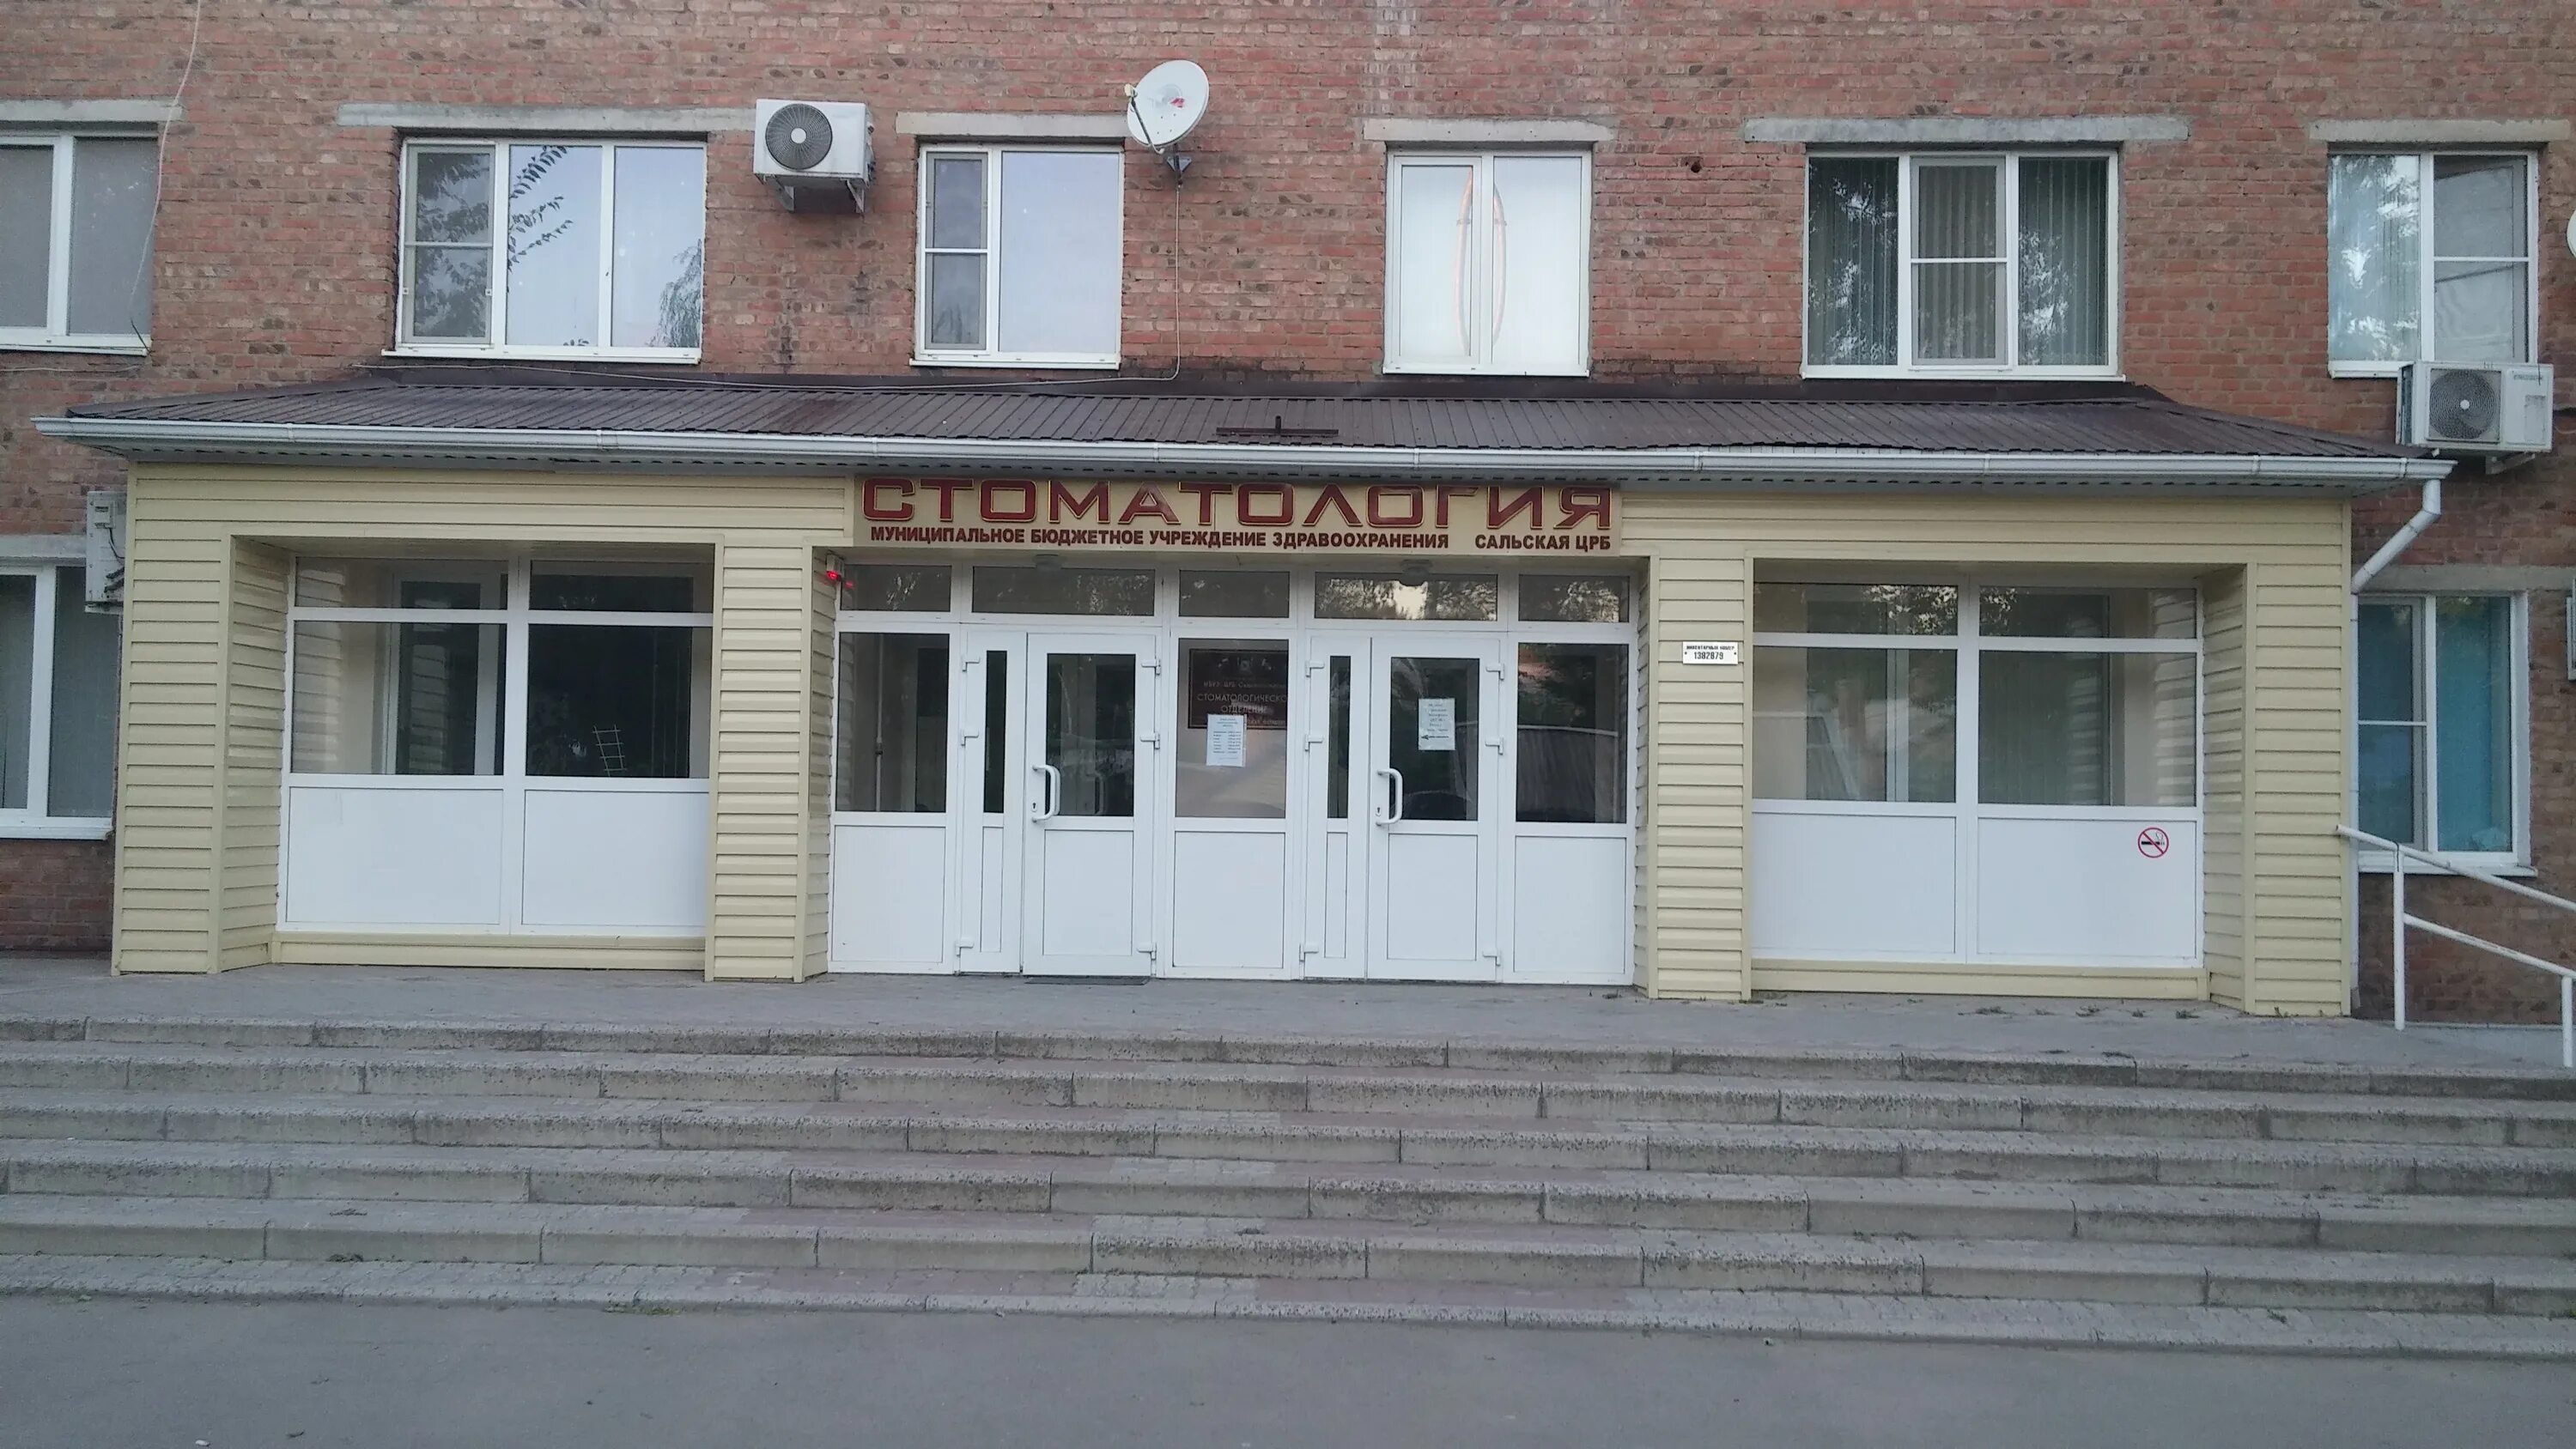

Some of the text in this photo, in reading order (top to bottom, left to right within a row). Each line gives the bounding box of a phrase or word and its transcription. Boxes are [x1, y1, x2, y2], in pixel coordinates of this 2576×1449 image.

[862, 477, 1613, 529] СТОМАТОЛОГИЯ
[871, 526, 1611, 552] МУНИЦИПАЛЬНОЕ БЮДЖЕТНОЕ УЧРЕЖДЕНИЕ ЗДРАВООХРАНЕНИЯ САЛЬСКАЯ ЦРБ
[1694, 652, 1724, 660] 1382879
